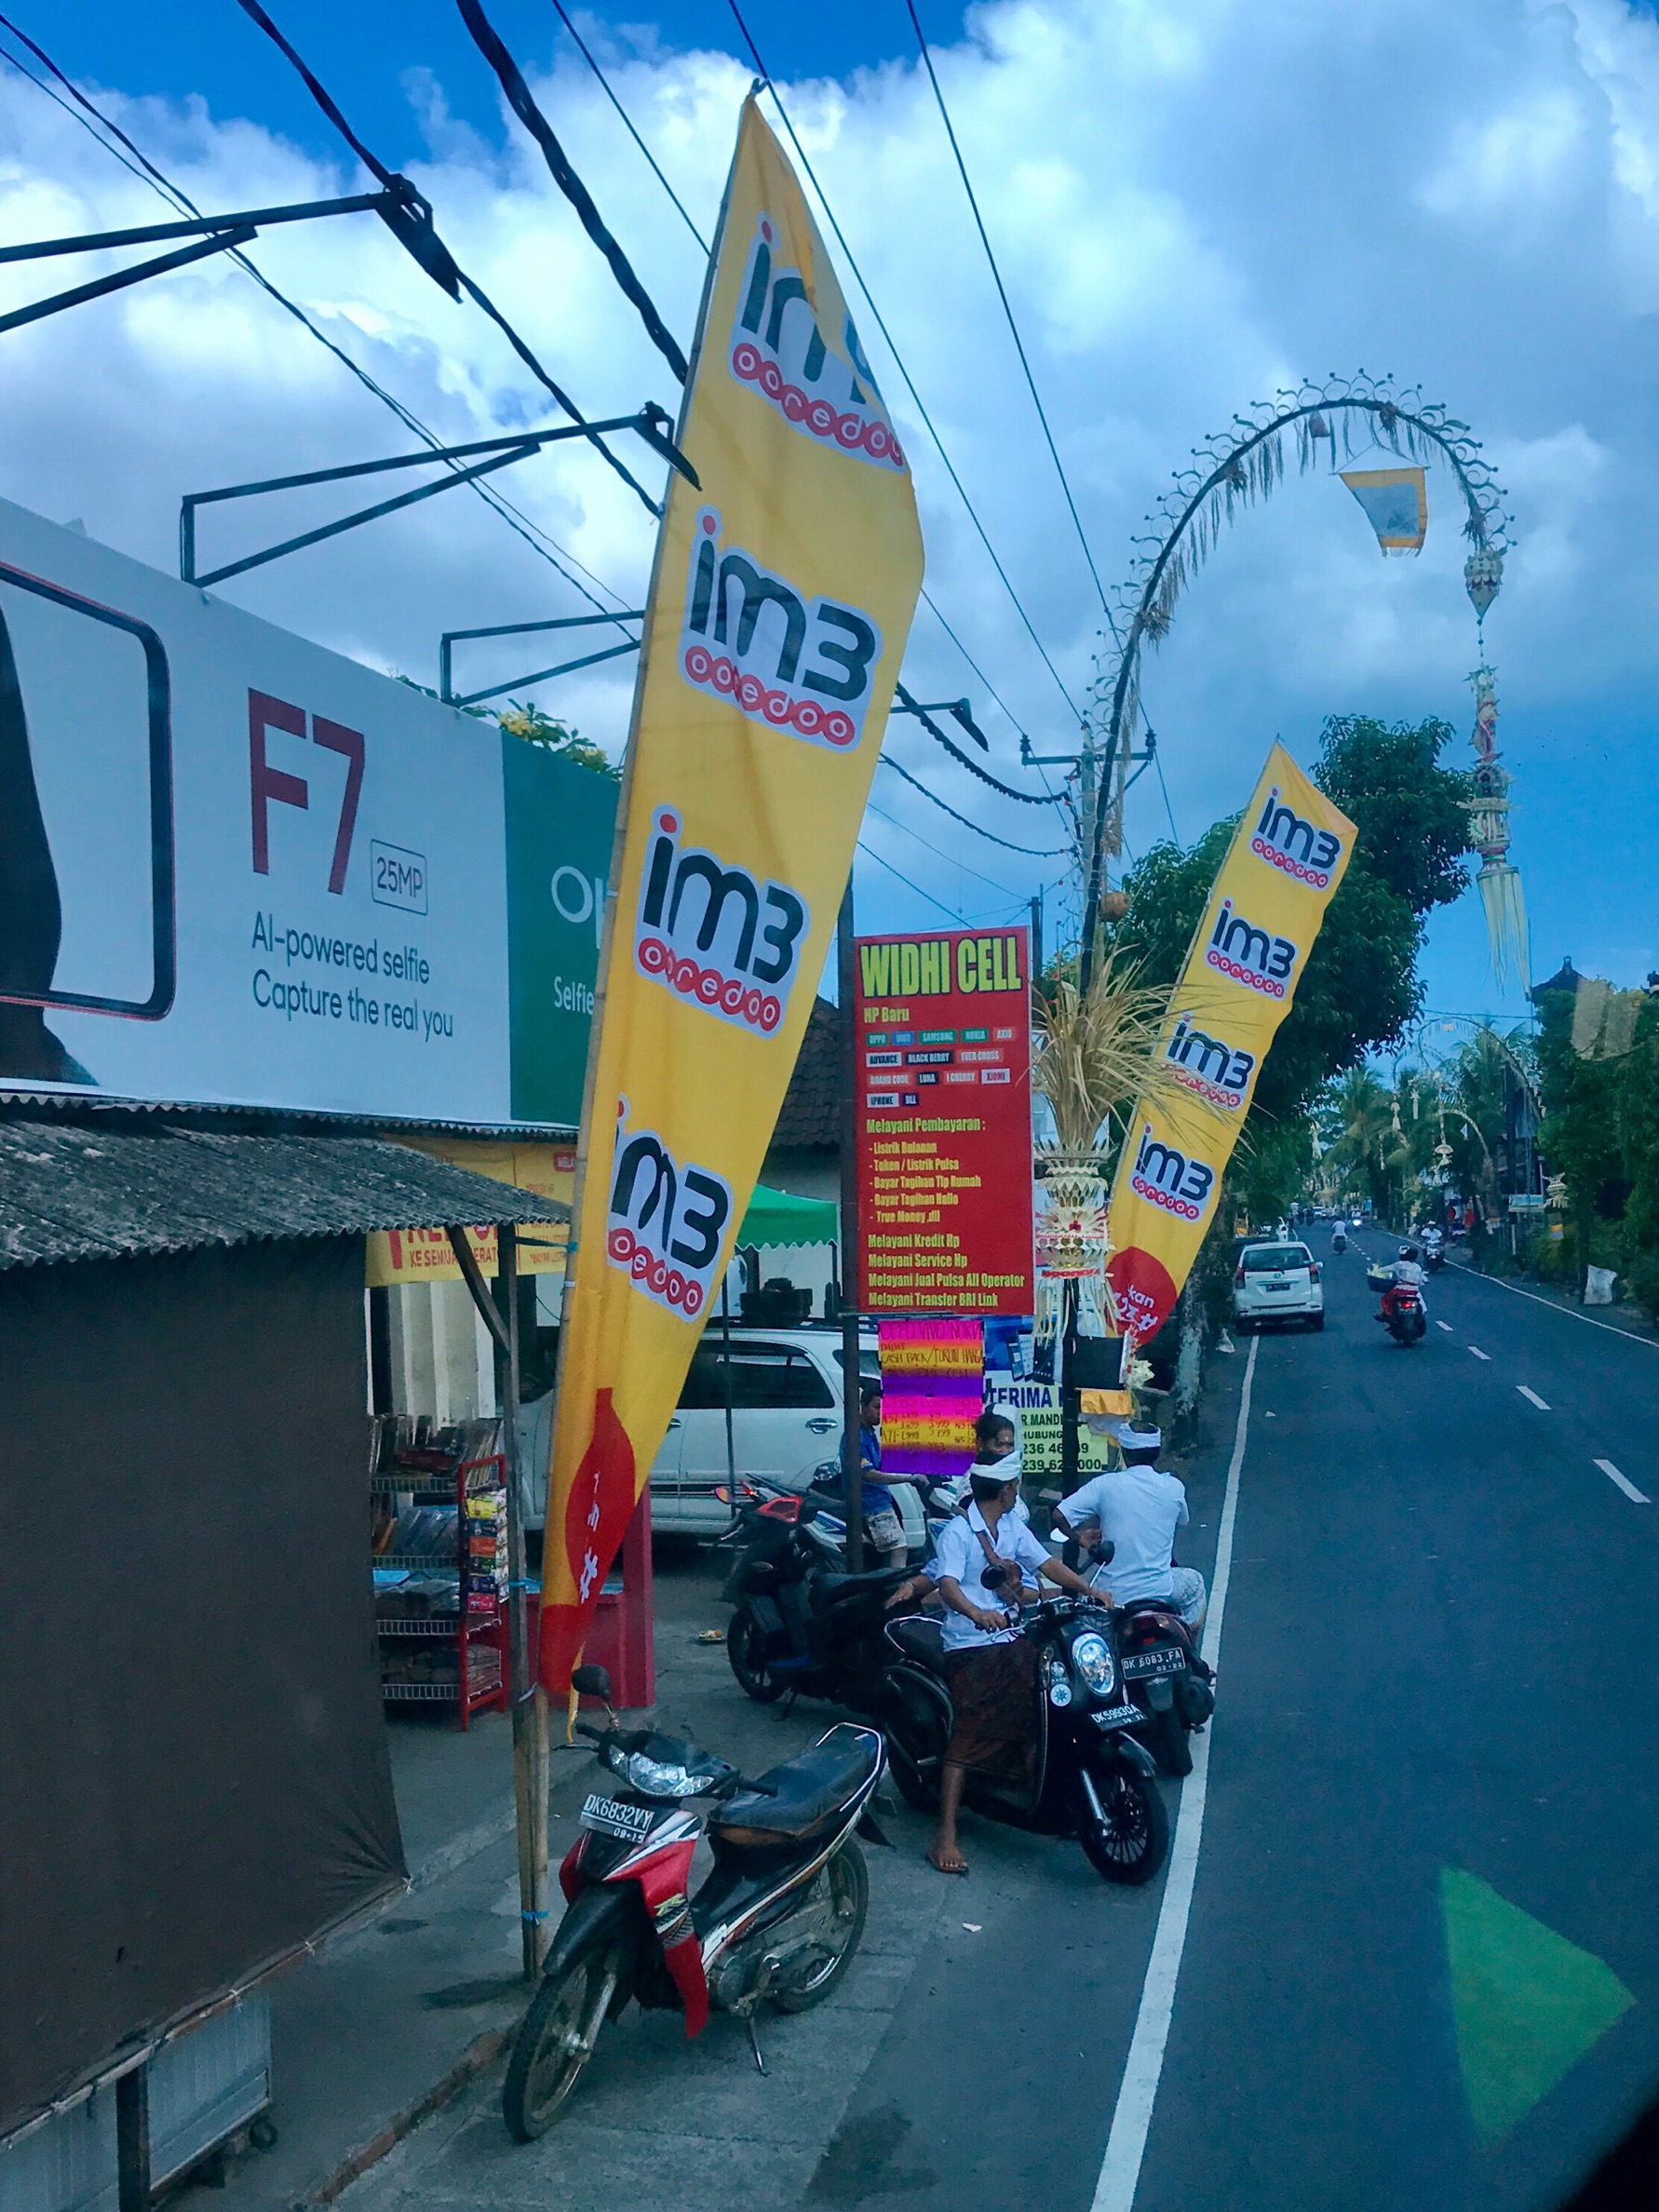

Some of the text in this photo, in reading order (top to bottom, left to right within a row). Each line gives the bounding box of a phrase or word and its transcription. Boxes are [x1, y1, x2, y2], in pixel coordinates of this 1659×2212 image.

[689, 514, 875, 701] im3
[685, 645, 855, 746] ooedoo
[249, 687, 365, 895] F7
[1258, 788, 1340, 869] im3
[376, 856, 424, 897] 25MP
[642, 814, 803, 984] im3
[252, 910, 430, 984] AI-powered selfie
[1212, 900, 1296, 978] im3
[859, 936, 1021, 998] WIDHI CELL
[554, 976, 594, 1015] Selfie
[253, 969, 453, 1043] Capture the real you
[864, 1007, 910, 1023] HP Baru
[923, 1031, 954, 1043] SAMSUNG
[870, 1054, 897, 1065] ADVANCE
[908, 1054, 928, 1063] BLACK
[1167, 1016, 1253, 1089] im3
[867, 1118, 913, 1134] Melayani
[915, 1117, 980, 1133] Pembayaran
[873, 1142, 900, 1154] Listrik
[901, 1141, 937, 1153] Bulanan
[874, 1159, 900, 1171] Token
[907, 1158, 934, 1171] Listrik
[935, 1157, 959, 1170] Pulsa
[1136, 1126, 1213, 1201] im3
[874, 1177, 899, 1190] Bayar
[899, 1176, 934, 1189] Tagihan
[951, 1175, 981, 1187] Rumah
[874, 1194, 899, 1207] Bayar
[900, 1193, 935, 1207] Tagihan
[877, 1211, 896, 1222] True
[897, 1210, 926, 1223] Money
[868, 1234, 960, 1248] Melayani Kredit Hp
[410, 1250, 422, 1267] KE
[868, 1253, 967, 1268] Melayani Service Hp
[869, 1273, 1025, 1288] Melayani Jual Pulsa All Operator
[869, 1292, 998, 1307] Melayani Transfer BRI Link
[1124, 1659, 1135, 1669] DK
[583, 1793, 654, 1829] DK6832VY
